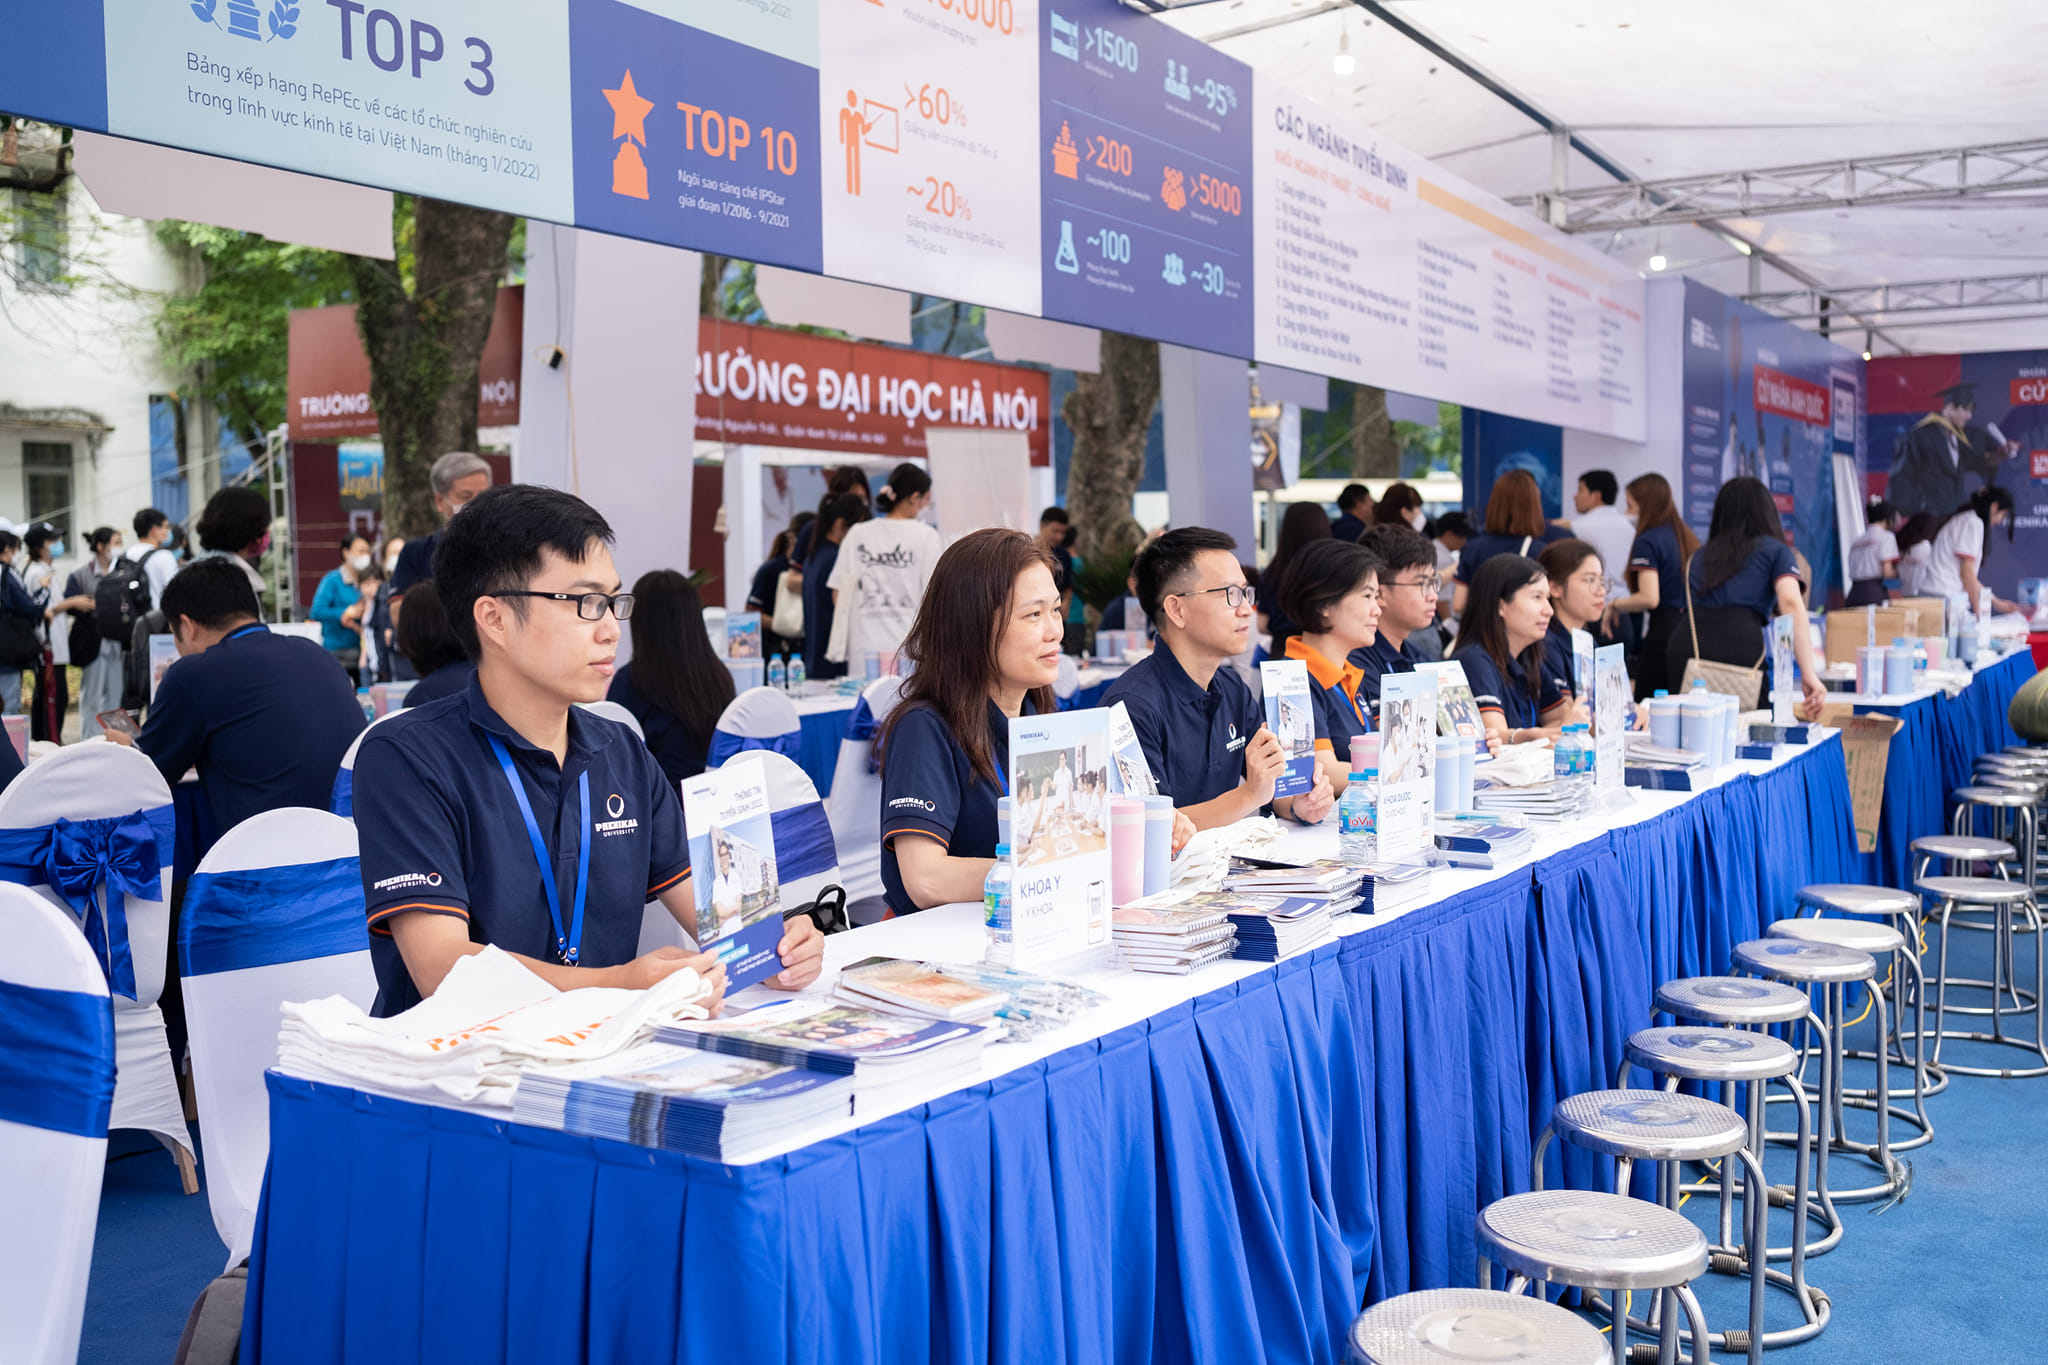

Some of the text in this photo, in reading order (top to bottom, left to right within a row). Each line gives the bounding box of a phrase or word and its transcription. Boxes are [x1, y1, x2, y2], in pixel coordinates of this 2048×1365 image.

[327, 0, 495, 96] TOP 3
[1084, 26, 1138, 73] >1500
[187, 52, 230, 82] Bảng
[236, 67, 263, 90] xếp
[269, 72, 307, 101] hạng
[312, 83, 360, 110] RePEc
[365, 98, 380, 115] về
[385, 104, 408, 122] các
[429, 114, 460, 134] chức
[464, 124, 507, 145] nghiên
[510, 135, 533, 151] cứu
[904, 82, 967, 127] >60%
[1192, 78, 1237, 116] ~95%
[188, 85, 541, 181] trong lĩnh vực kinh tế tại Việt Nam (tháng 1/2022)
[677, 101, 797, 176] TOP 10
[1275, 104, 1408, 192] CÁC NGÀNH TUYỂN SINH
[1086, 135, 1132, 176] >200
[678, 169, 785, 205] Ngôi sao sáng chế IPStar
[907, 176, 972, 221] ~20%
[1190, 173, 1241, 216] >5000
[679, 194, 695, 208] giai
[698, 197, 720, 213] đoạn
[722, 202, 751, 220] 1/2016
[759, 210, 789, 227] 9/2021
[1086, 228, 1131, 264] ~100
[1191, 261, 1224, 296] ~30
[299, 377, 515, 417] TRƯỜNG NỘI
[696, 346, 808, 407] ƯỜNG
[816, 367, 870, 422] ĐẠI
[879, 375, 943, 428] HỌC
[951, 378, 987, 426] HÀ
[595, 819, 638, 832] PHENIKAA
[374, 873, 427, 890] PHENIKAA
[386, 880, 427, 891] UNIVERSITY
[1020, 875, 1061, 899] KHOA Y
